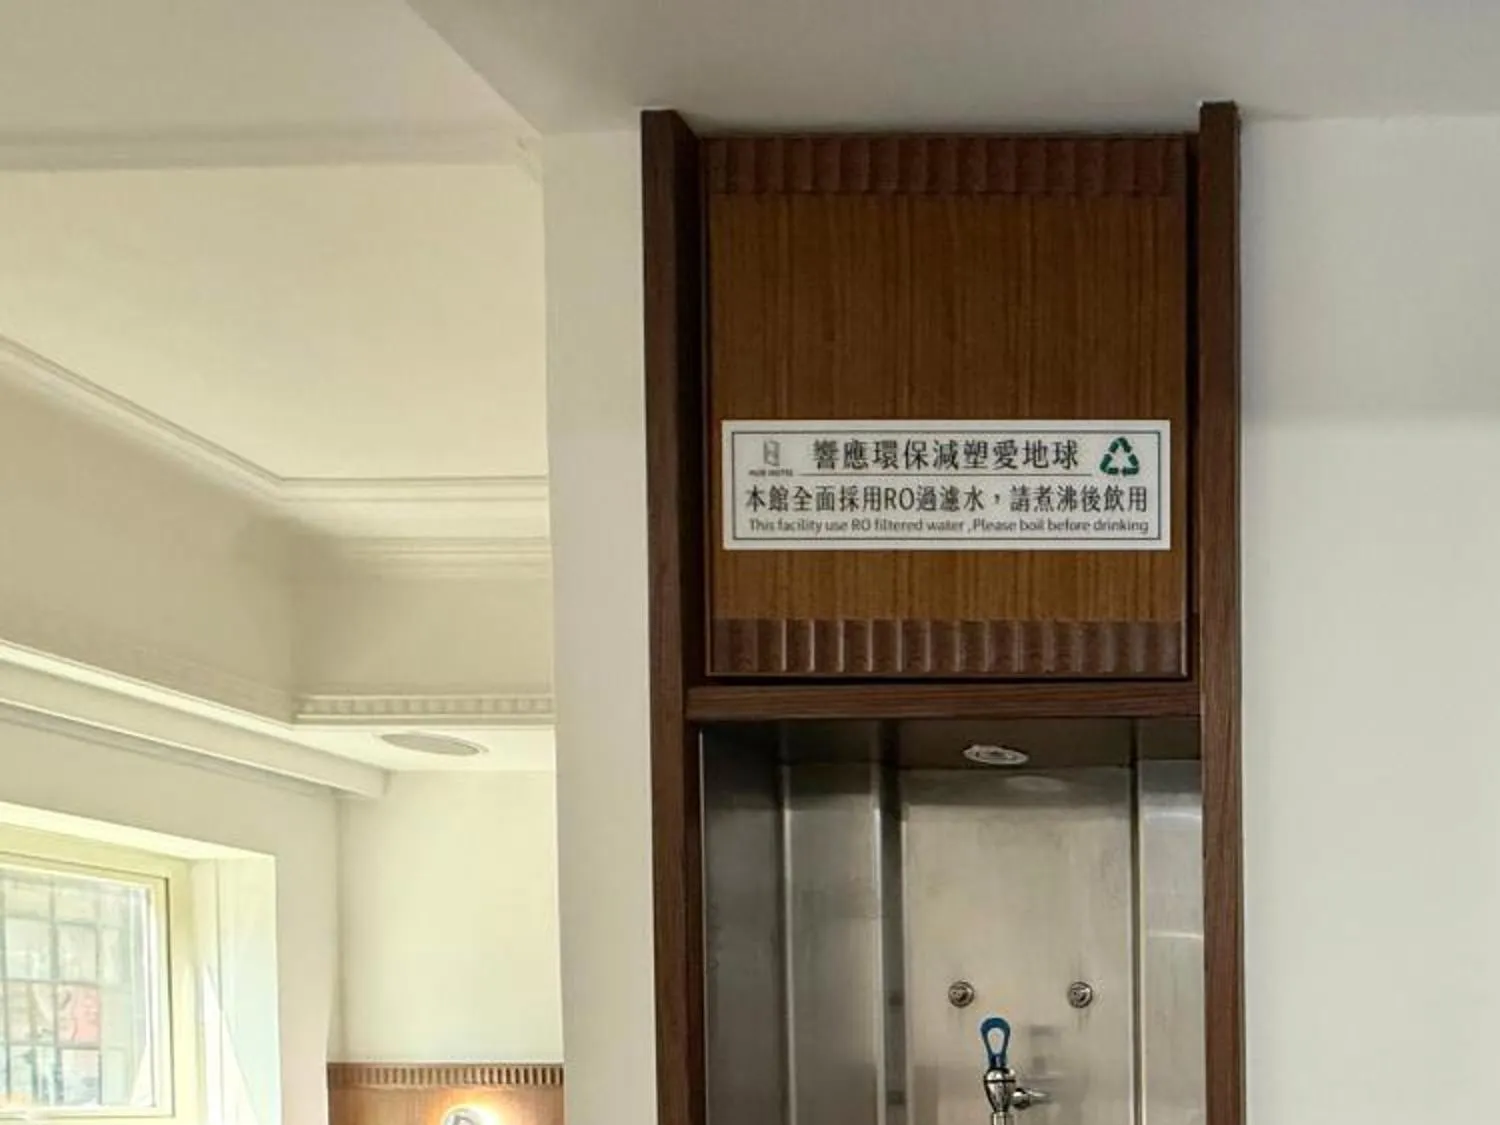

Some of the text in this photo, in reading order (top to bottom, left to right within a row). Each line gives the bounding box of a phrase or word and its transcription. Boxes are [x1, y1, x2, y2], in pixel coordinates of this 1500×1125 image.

[813, 438, 1079, 471] 響應環保減塑愛地球
[749, 518, 775, 531] This
[778, 518, 822, 534] facility
[824, 521, 848, 531] use
[851, 519, 871, 531] RO
[874, 518, 923, 531] filtered
[928, 519, 964, 531] water
[1020, 518, 1044, 531] boil
[1049, 518, 1091, 531] before
[1093, 518, 1149, 534] drinking
